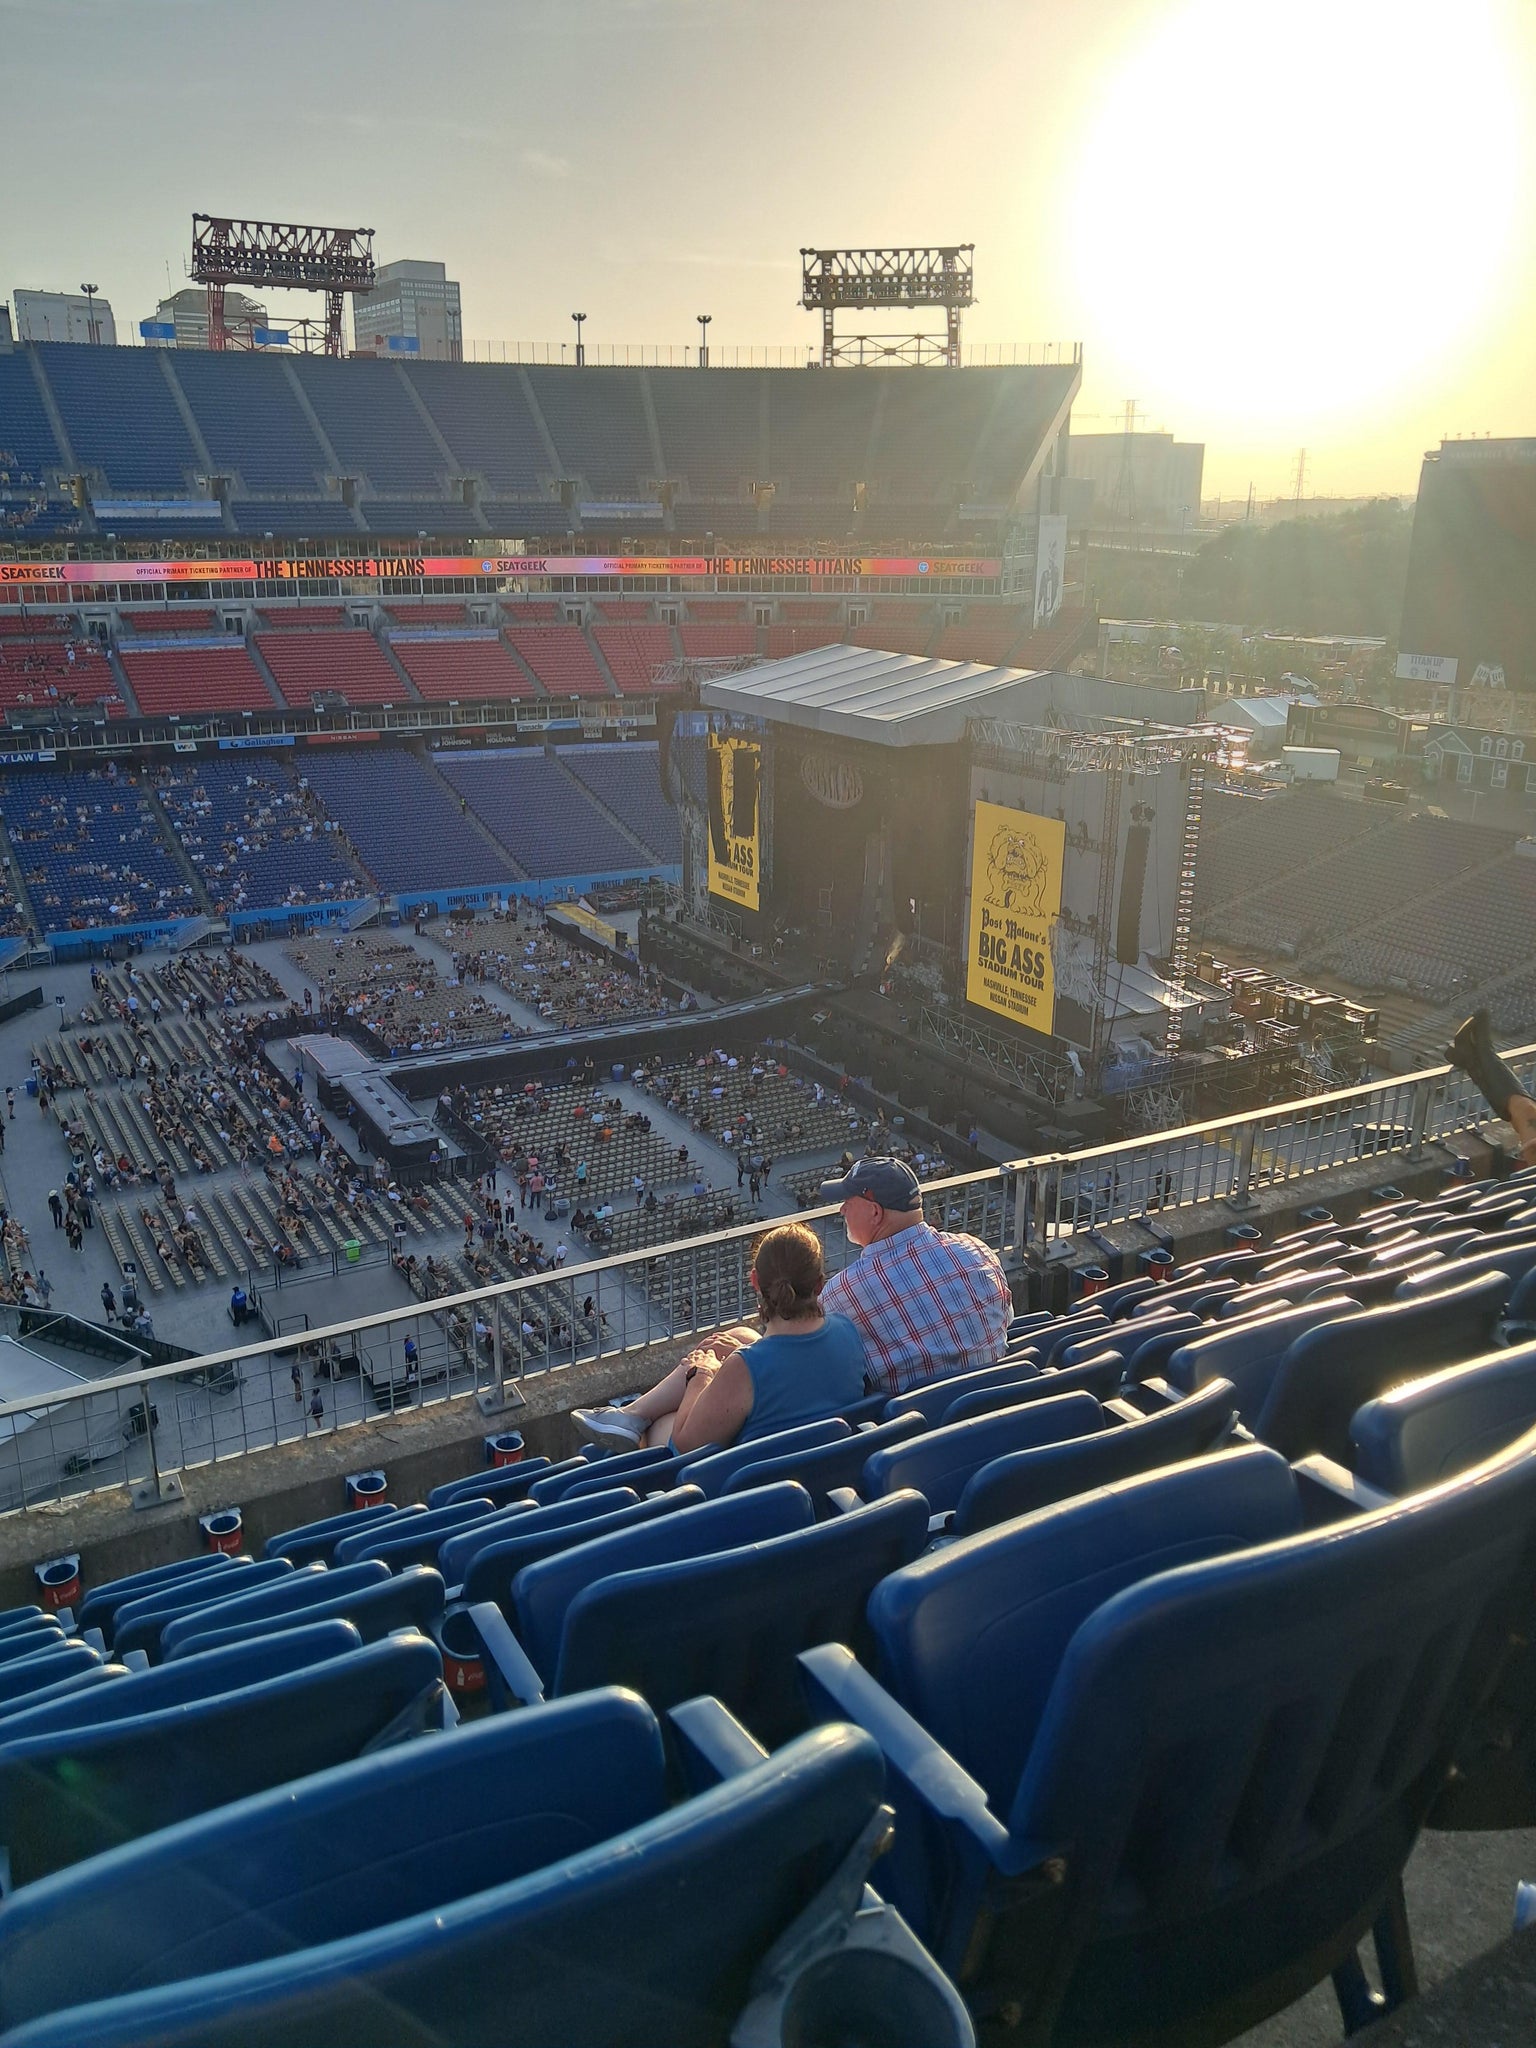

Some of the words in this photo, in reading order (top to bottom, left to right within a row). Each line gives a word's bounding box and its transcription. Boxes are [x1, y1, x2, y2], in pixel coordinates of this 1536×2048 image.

[1, 566, 67, 580] SEATGEEK
[254, 560, 282, 578] THE
[288, 559, 371, 578] TENNESSEE
[377, 558, 426, 577] TITANS
[497, 560, 548, 572] SEATGEEK
[703, 558, 730, 575] THE
[735, 558, 810, 575] TENNESSEE
[815, 558, 862, 575] TITANS
[933, 561, 985, 574] SEATGEEK
[11, 753, 34, 763] LAW
[734, 843, 754, 868] ASS
[982, 907, 1002, 930] Post
[1005, 919, 1046, 945] Malone's
[979, 931, 1007, 965] BIG
[1011, 944, 1045, 979] ASS
[978, 957, 1017, 981] STADIUM
[1019, 972, 1044, 991] TOUR
[983, 976, 1009, 997] NASHVILLE,
[1010, 988, 1037, 1007] TENNESSEE
[989, 991, 1007, 1007] NISSAN
[1008, 1000, 1029, 1016] STADIUM
